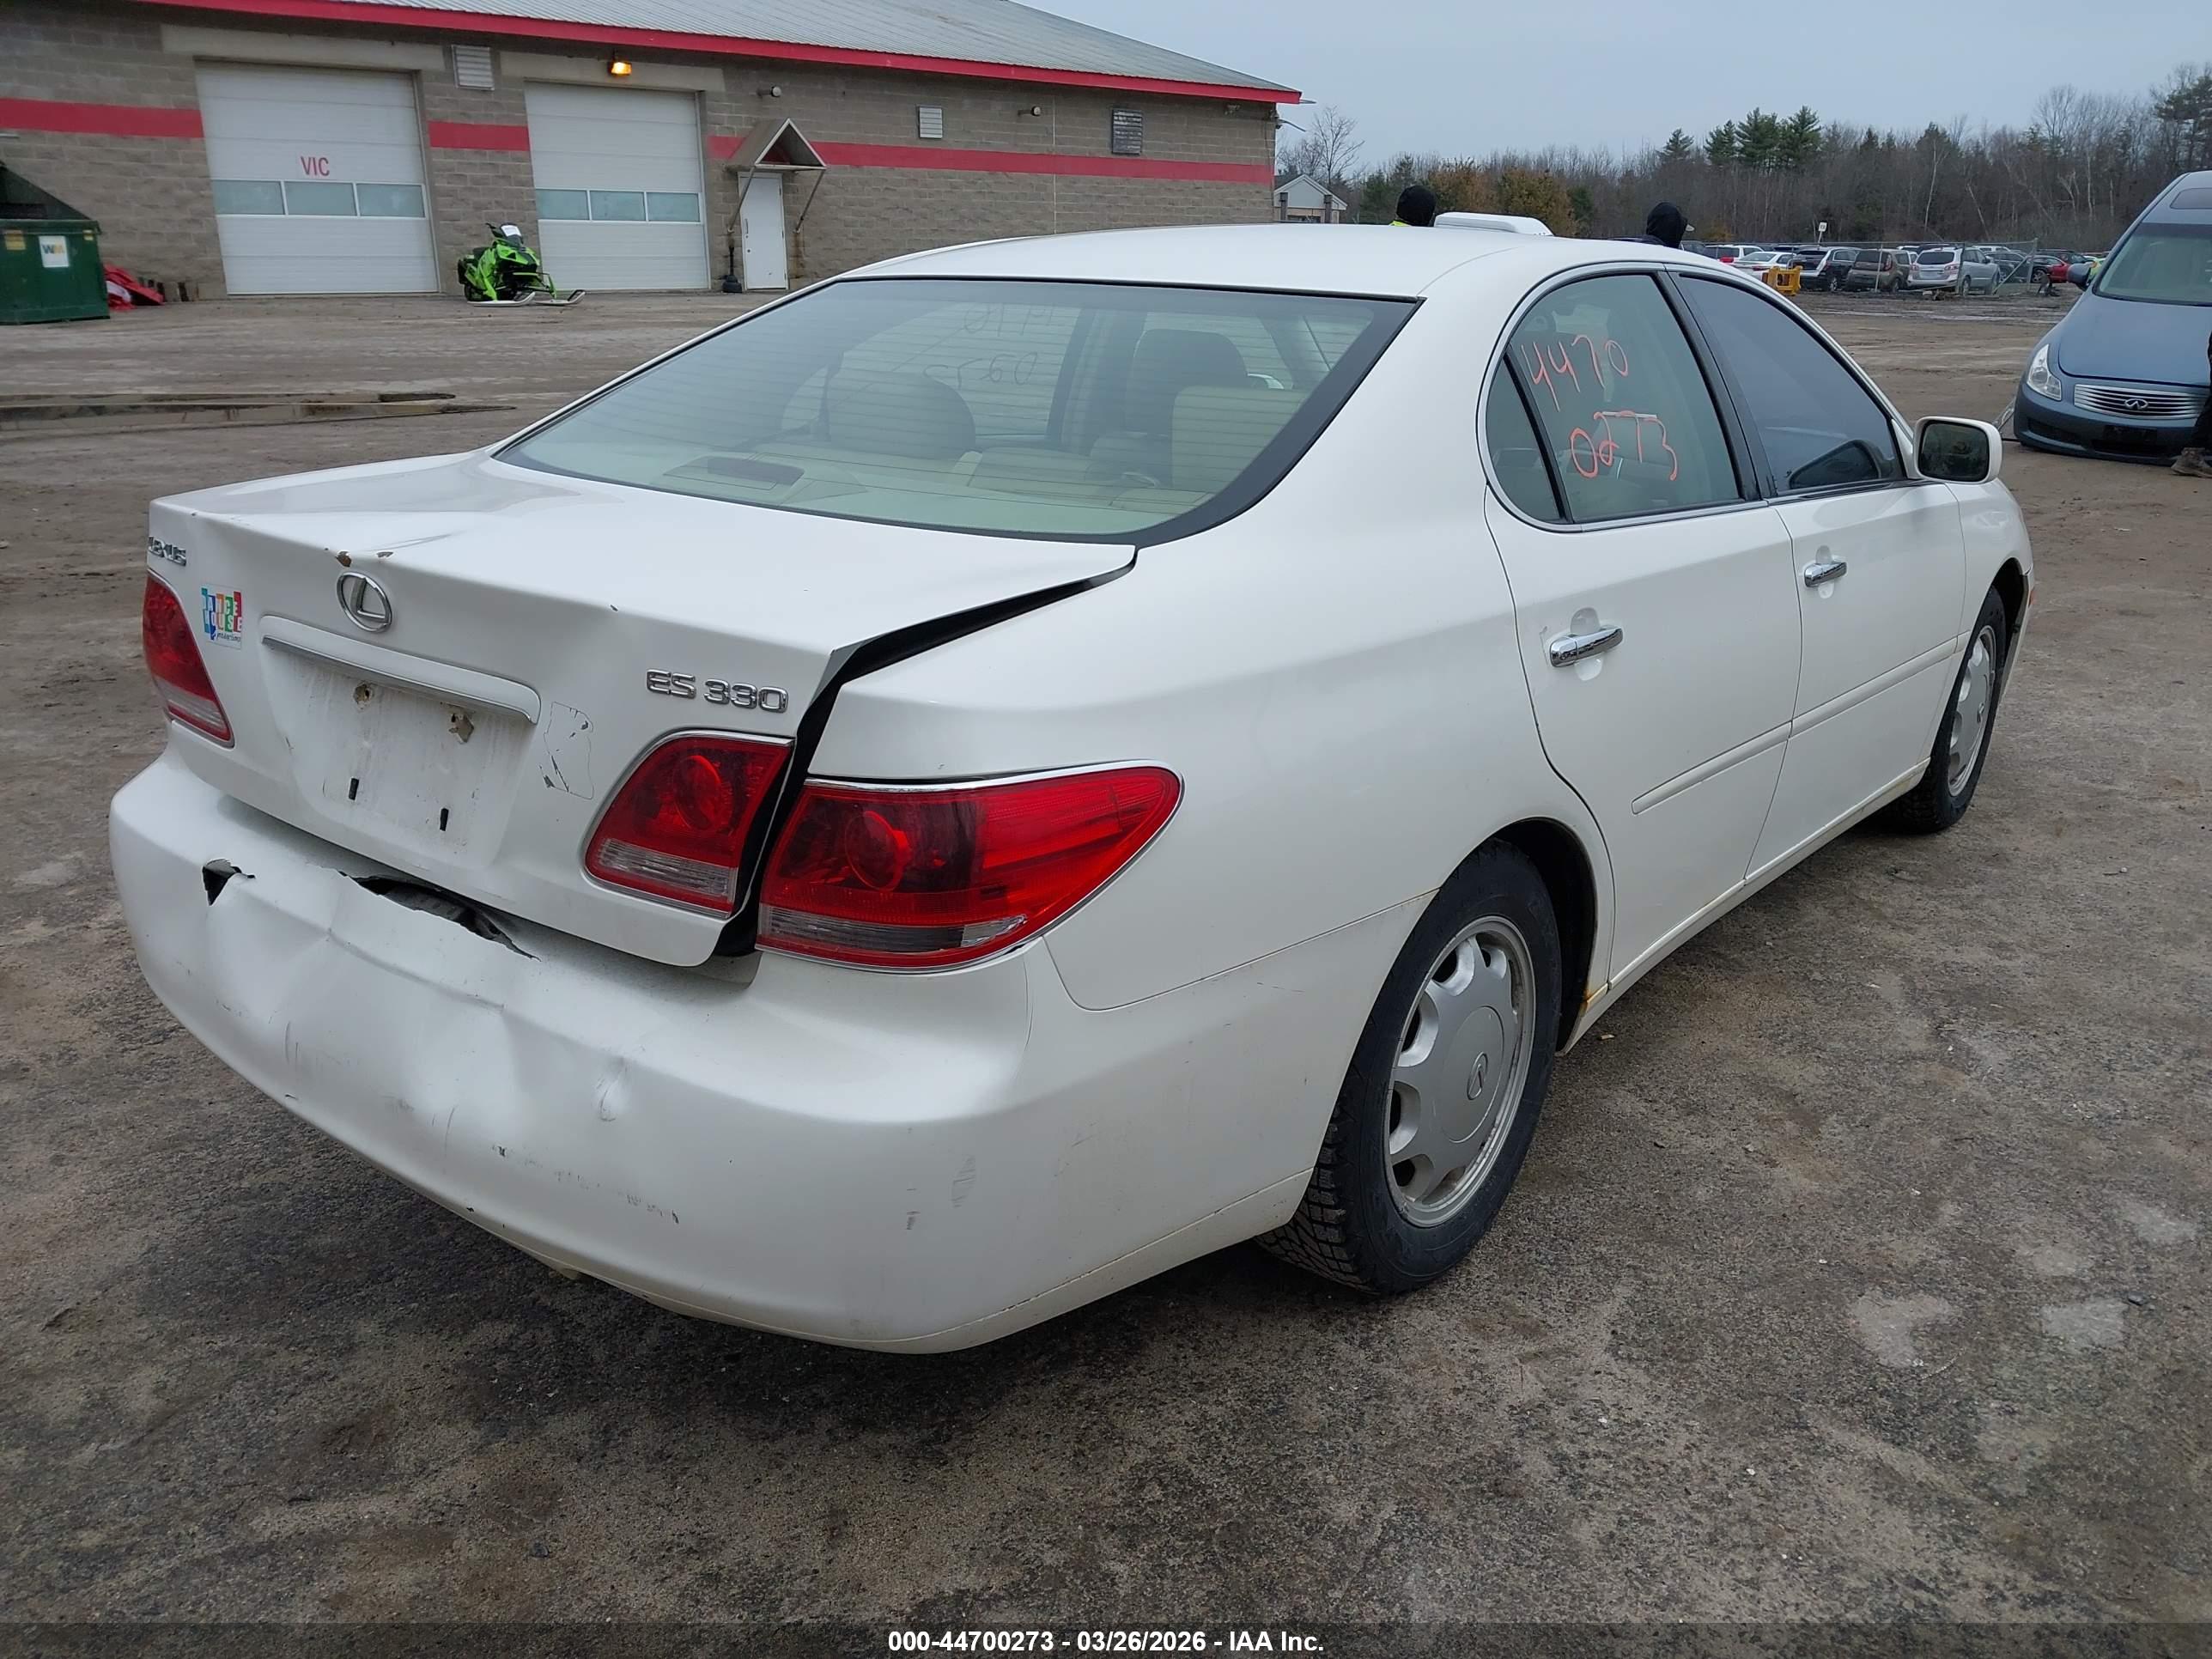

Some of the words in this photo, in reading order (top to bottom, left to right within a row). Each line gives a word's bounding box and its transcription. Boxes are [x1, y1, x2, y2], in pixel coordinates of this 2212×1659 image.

[301, 155, 330, 177] VIC
[1521, 334, 1628, 412] 4470
[647, 669, 696, 699] ES
[703, 678, 789, 714] 330
